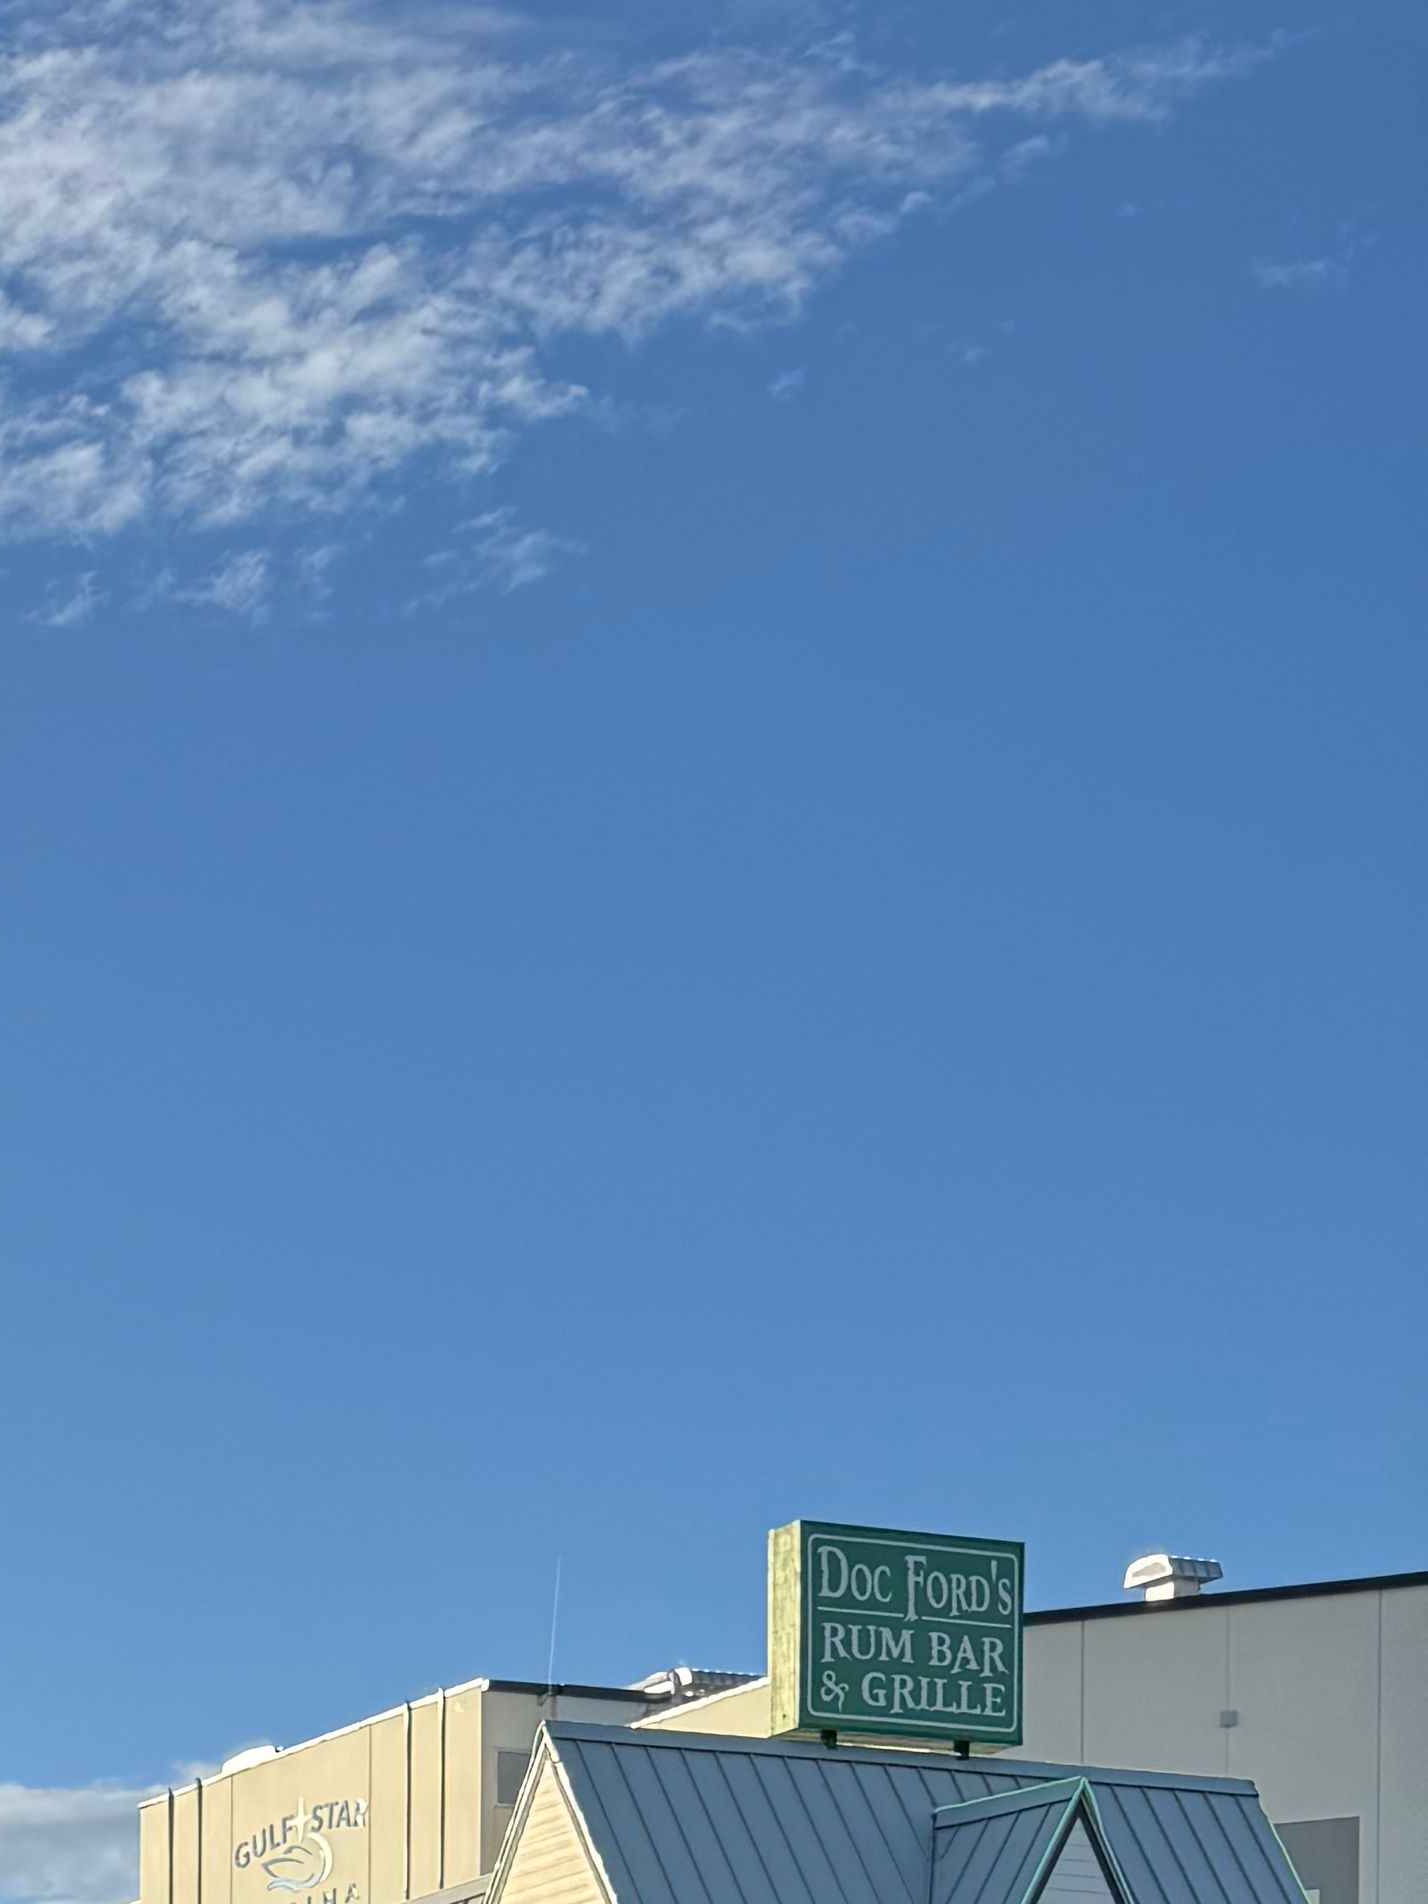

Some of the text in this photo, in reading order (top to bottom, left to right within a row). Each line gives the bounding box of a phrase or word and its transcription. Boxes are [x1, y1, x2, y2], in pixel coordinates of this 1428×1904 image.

[820, 1622, 1009, 1678] RUM BAR
[820, 1670, 1006, 1717] & GRILLE
[234, 1798, 369, 1869] GULF STAR
